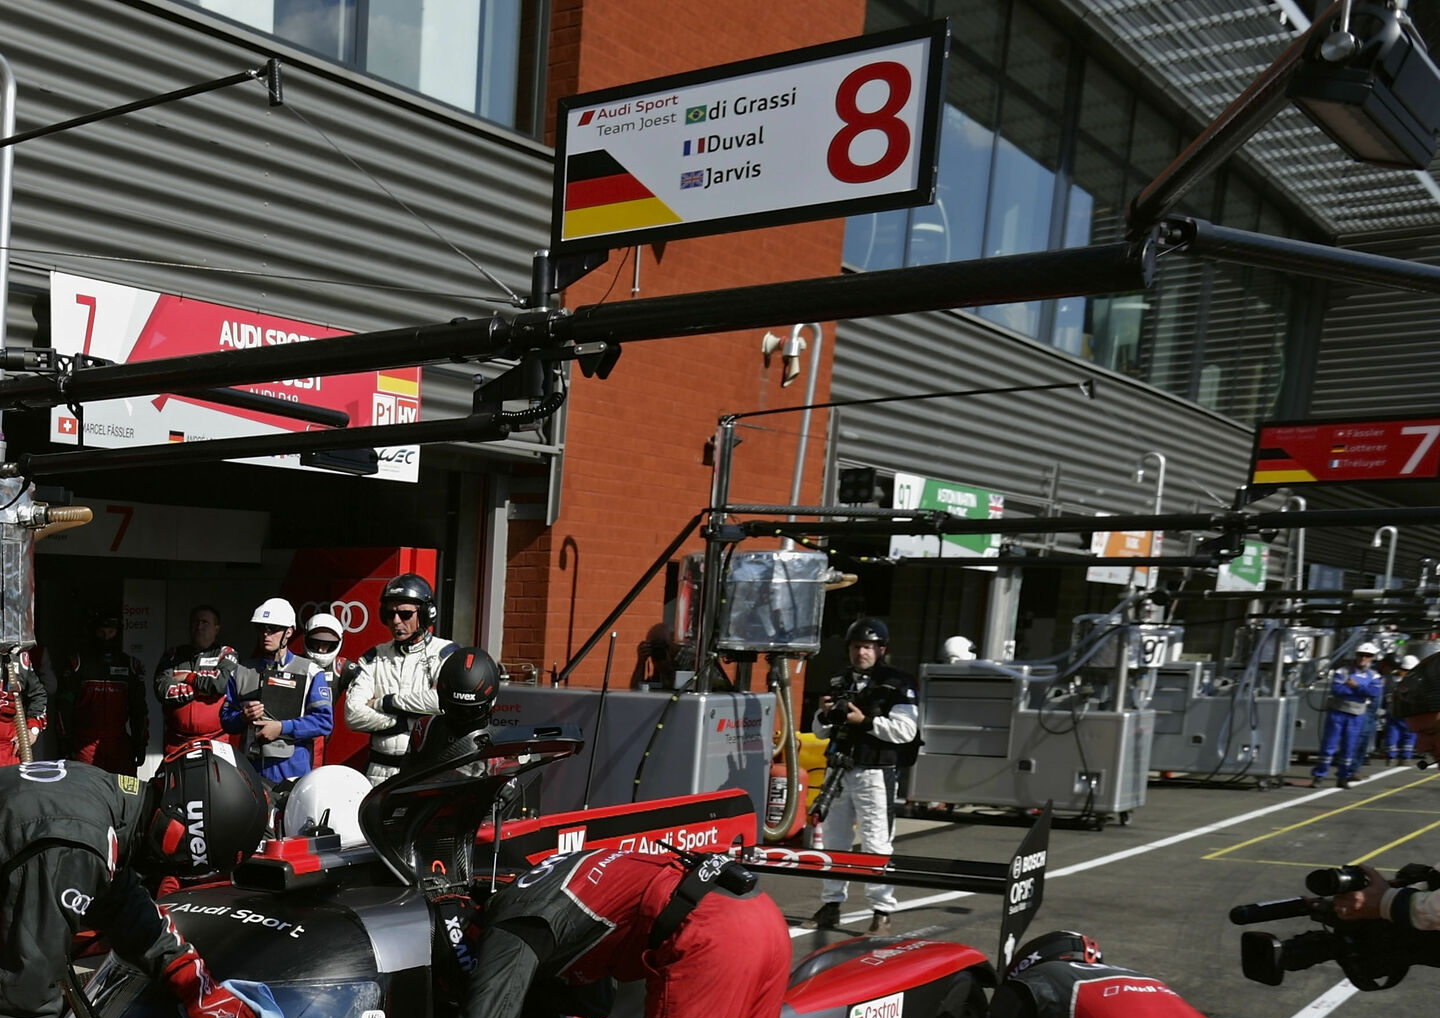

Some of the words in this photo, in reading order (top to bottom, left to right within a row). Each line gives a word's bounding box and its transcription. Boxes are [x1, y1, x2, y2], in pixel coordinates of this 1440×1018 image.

[597, 103, 632, 121] Audi
[635, 94, 679, 114] Sport
[708, 99, 729, 121] di
[733, 87, 797, 117] Grassi
[597, 120, 635, 137] Team
[638, 111, 677, 130] Joest
[827, 61, 912, 184] 8
[707, 126, 765, 153] Duval
[704, 161, 761, 189] Jarvis
[76, 293, 96, 355] 7
[219, 320, 263, 349] AUDI
[376, 401, 392, 423] P1
[378, 448, 416, 464] WEC
[1400, 425, 1440, 475] 7
[107, 506, 134, 551] 7
[453, 691, 476, 701] uvex
[186, 801, 209, 867] uvex
[638, 832, 673, 855] Audi
[677, 826, 717, 850] Sport
[1022, 850, 1047, 872] BOSCH
[172, 903, 231, 915] Audi
[230, 909, 305, 938] Sport
[1009, 951, 1043, 977] vex
